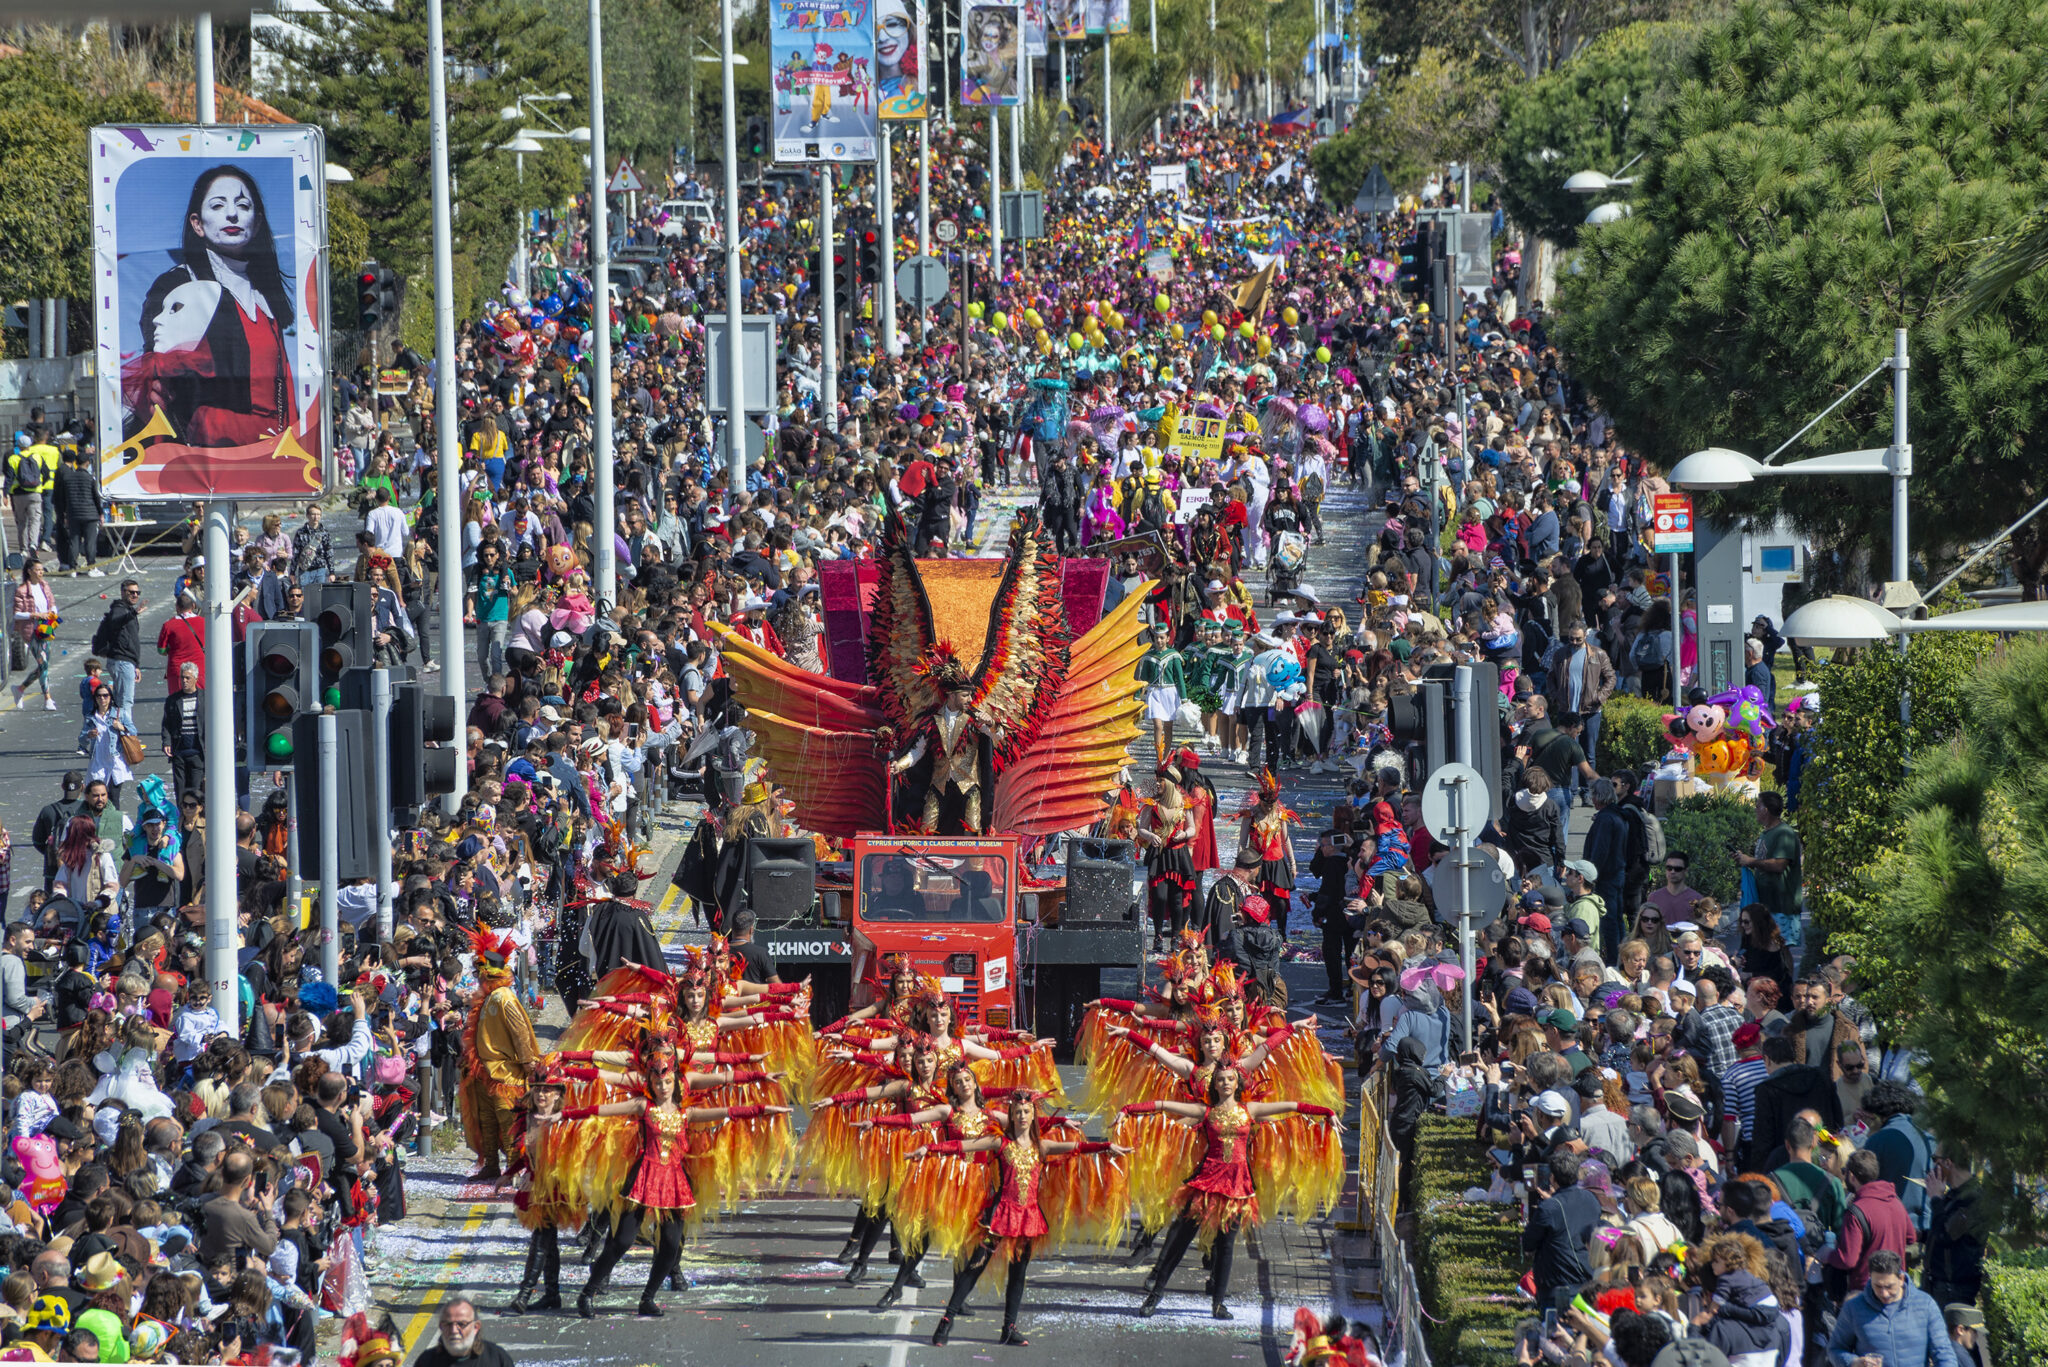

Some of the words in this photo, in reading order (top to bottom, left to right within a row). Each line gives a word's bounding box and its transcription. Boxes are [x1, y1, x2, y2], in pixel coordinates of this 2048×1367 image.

[939, 223, 956, 238] 50
[1662, 518, 1668, 526] 2
[767, 941, 852, 956] ΣΚΗΝΟΤΕΧ
[214, 980, 229, 991] 15
